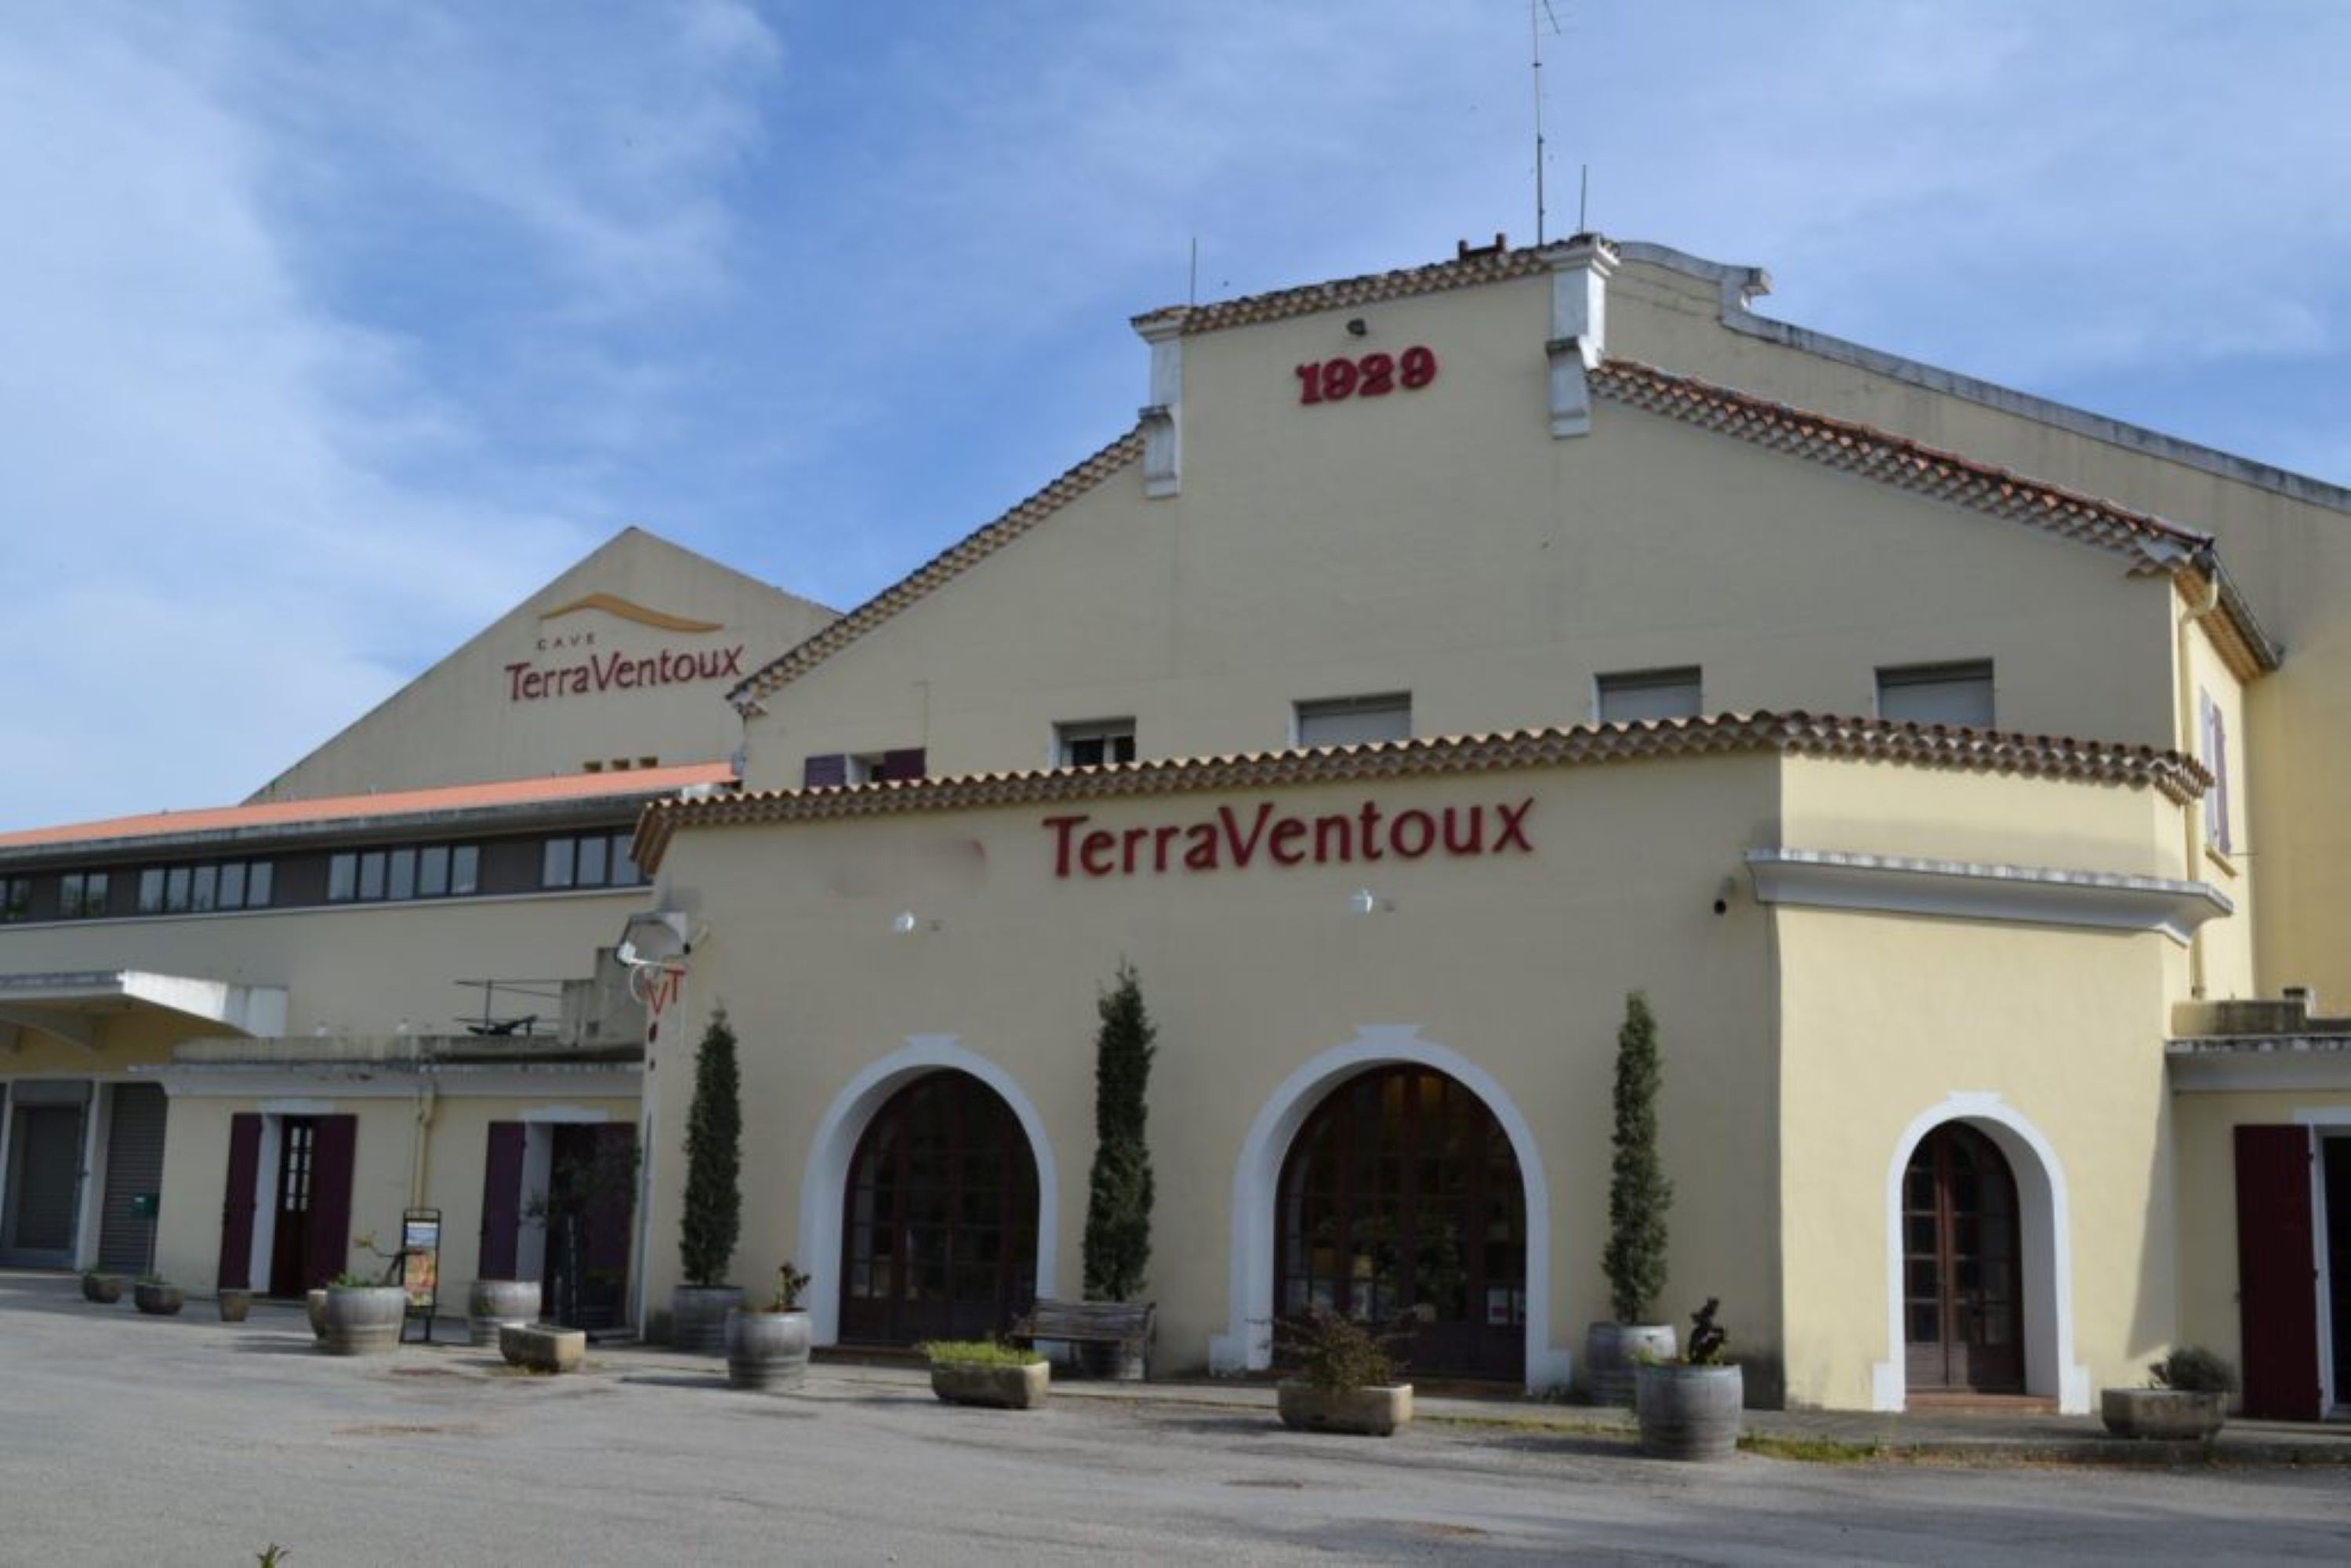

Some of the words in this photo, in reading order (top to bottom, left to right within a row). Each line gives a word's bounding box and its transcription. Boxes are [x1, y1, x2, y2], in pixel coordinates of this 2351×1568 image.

[1296, 345, 1436, 405] 1929
[537, 633, 595, 651] CAVE
[505, 645, 743, 701] TerraVentoux
[1043, 798, 1533, 878] TerraVentoux
